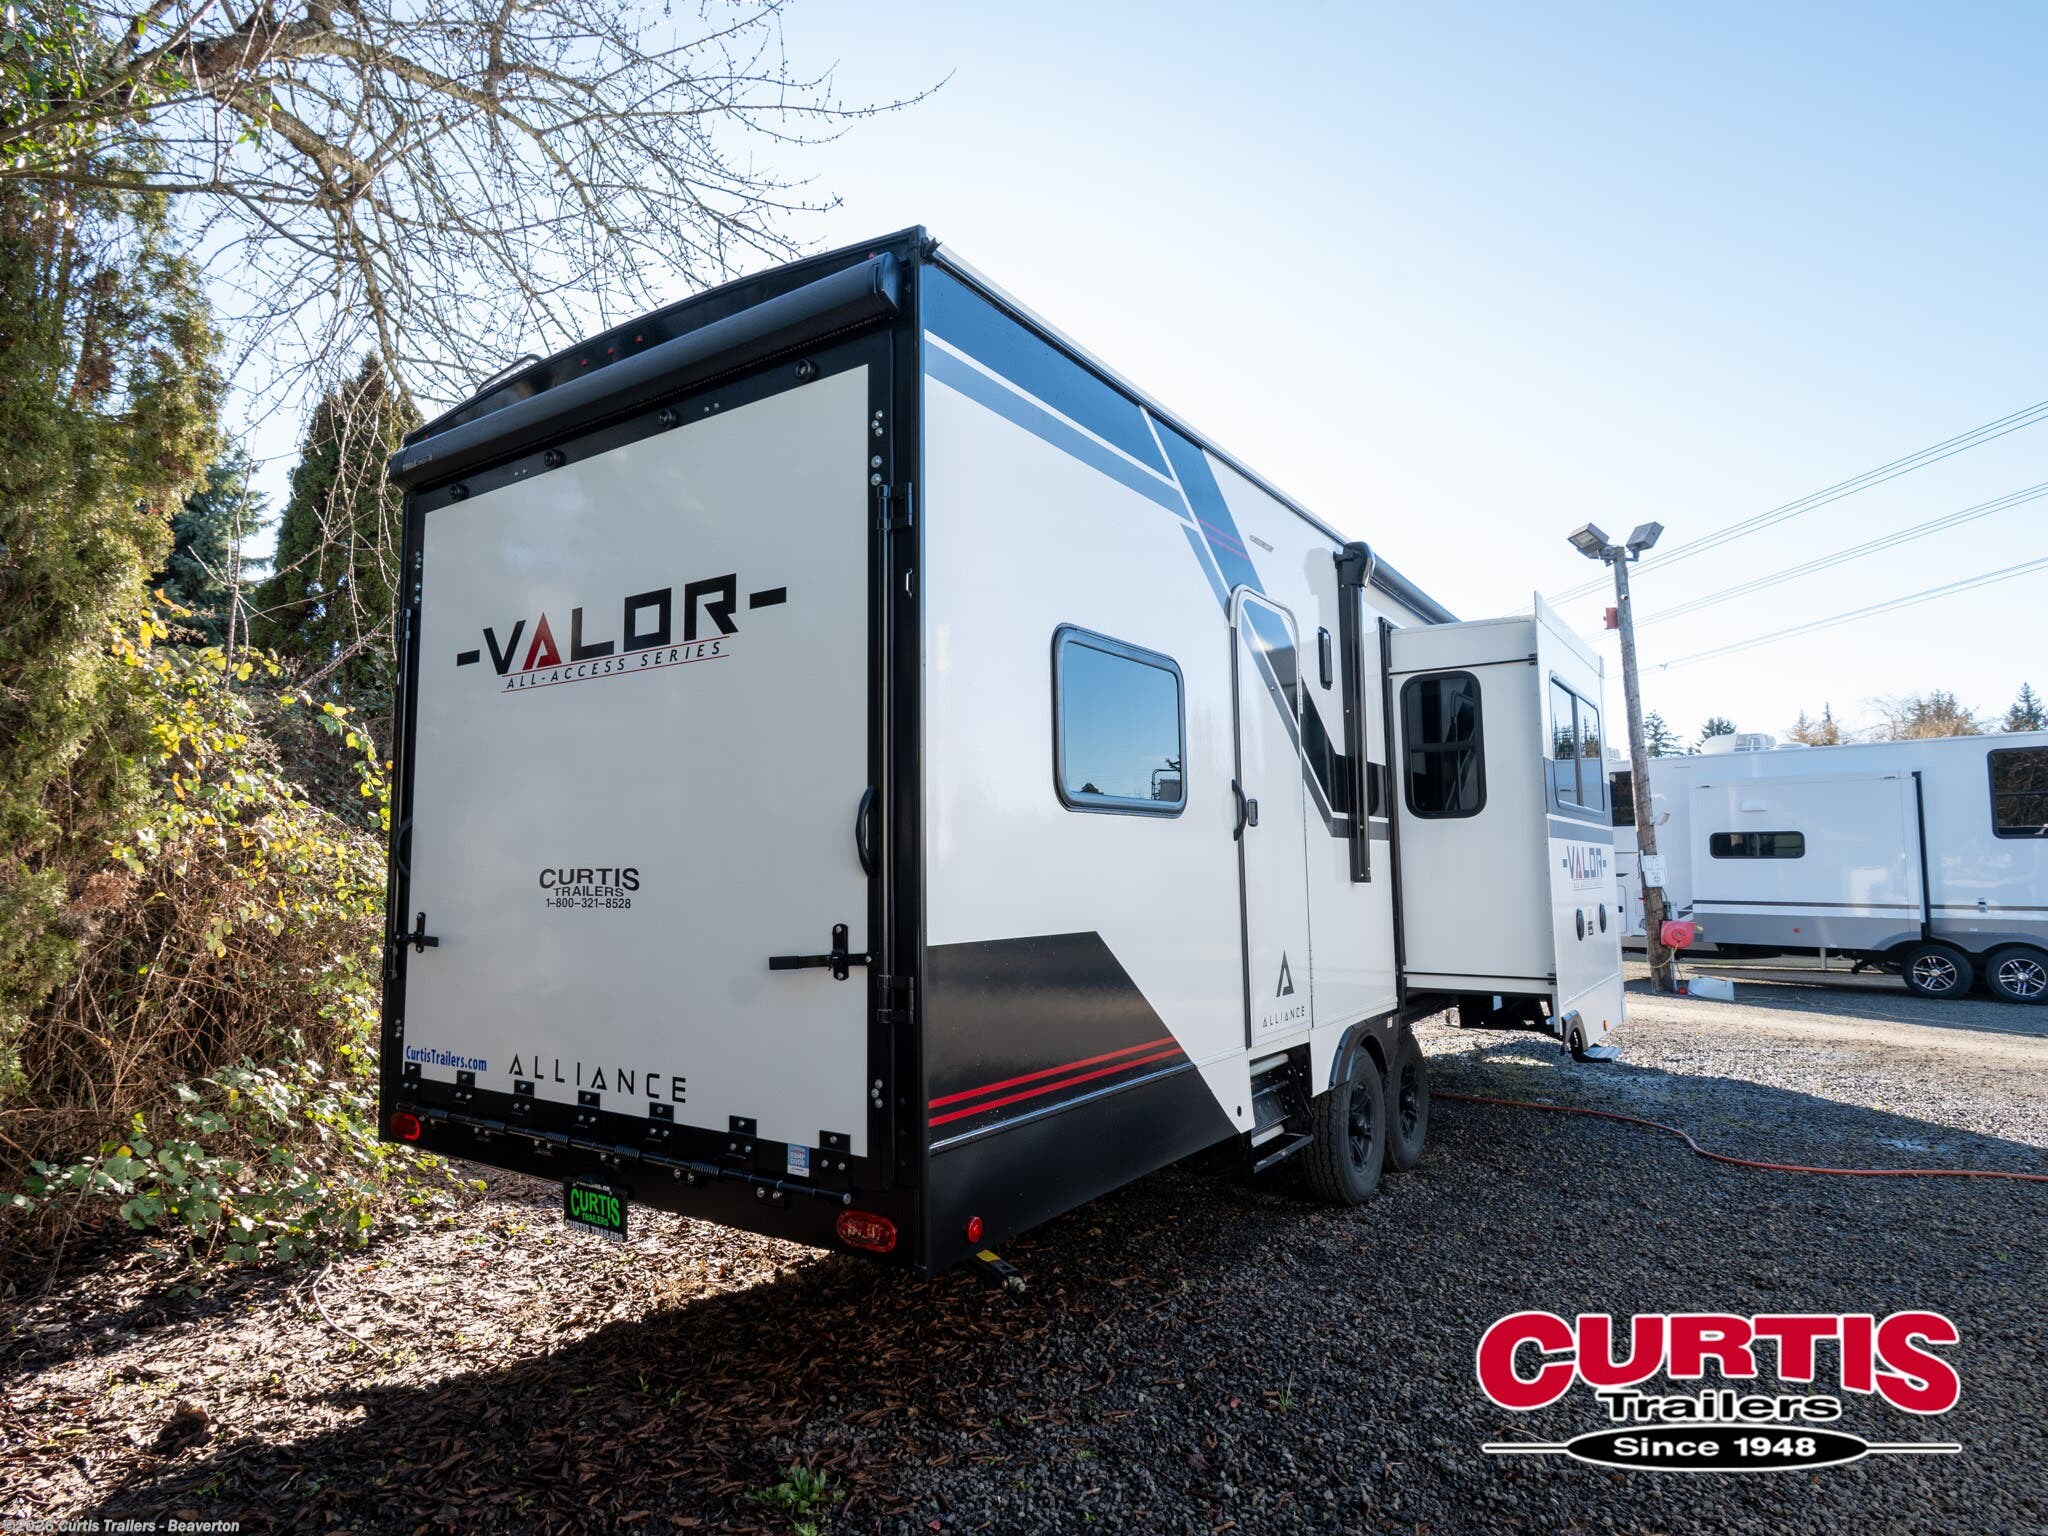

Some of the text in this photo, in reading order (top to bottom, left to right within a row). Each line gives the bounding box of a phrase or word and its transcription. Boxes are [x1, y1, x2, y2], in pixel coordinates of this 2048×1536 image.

[506, 641, 722, 690] ALL-ACCESS SERIES
[539, 867, 640, 892] CURTIS
[553, 885, 625, 897] TRAILERS
[546, 897, 632, 909] 1-800-321-8528
[1263, 1005, 1305, 1028] ALLIANCE
[405, 1045, 488, 1072] CurtisTrailers.com
[508, 1053, 687, 1104] ALLIANCE
[571, 1188, 620, 1227] CURTIS
[582, 1212, 609, 1227] TRAILERS
[565, 1219, 624, 1242] CURTIS TRAILERS
